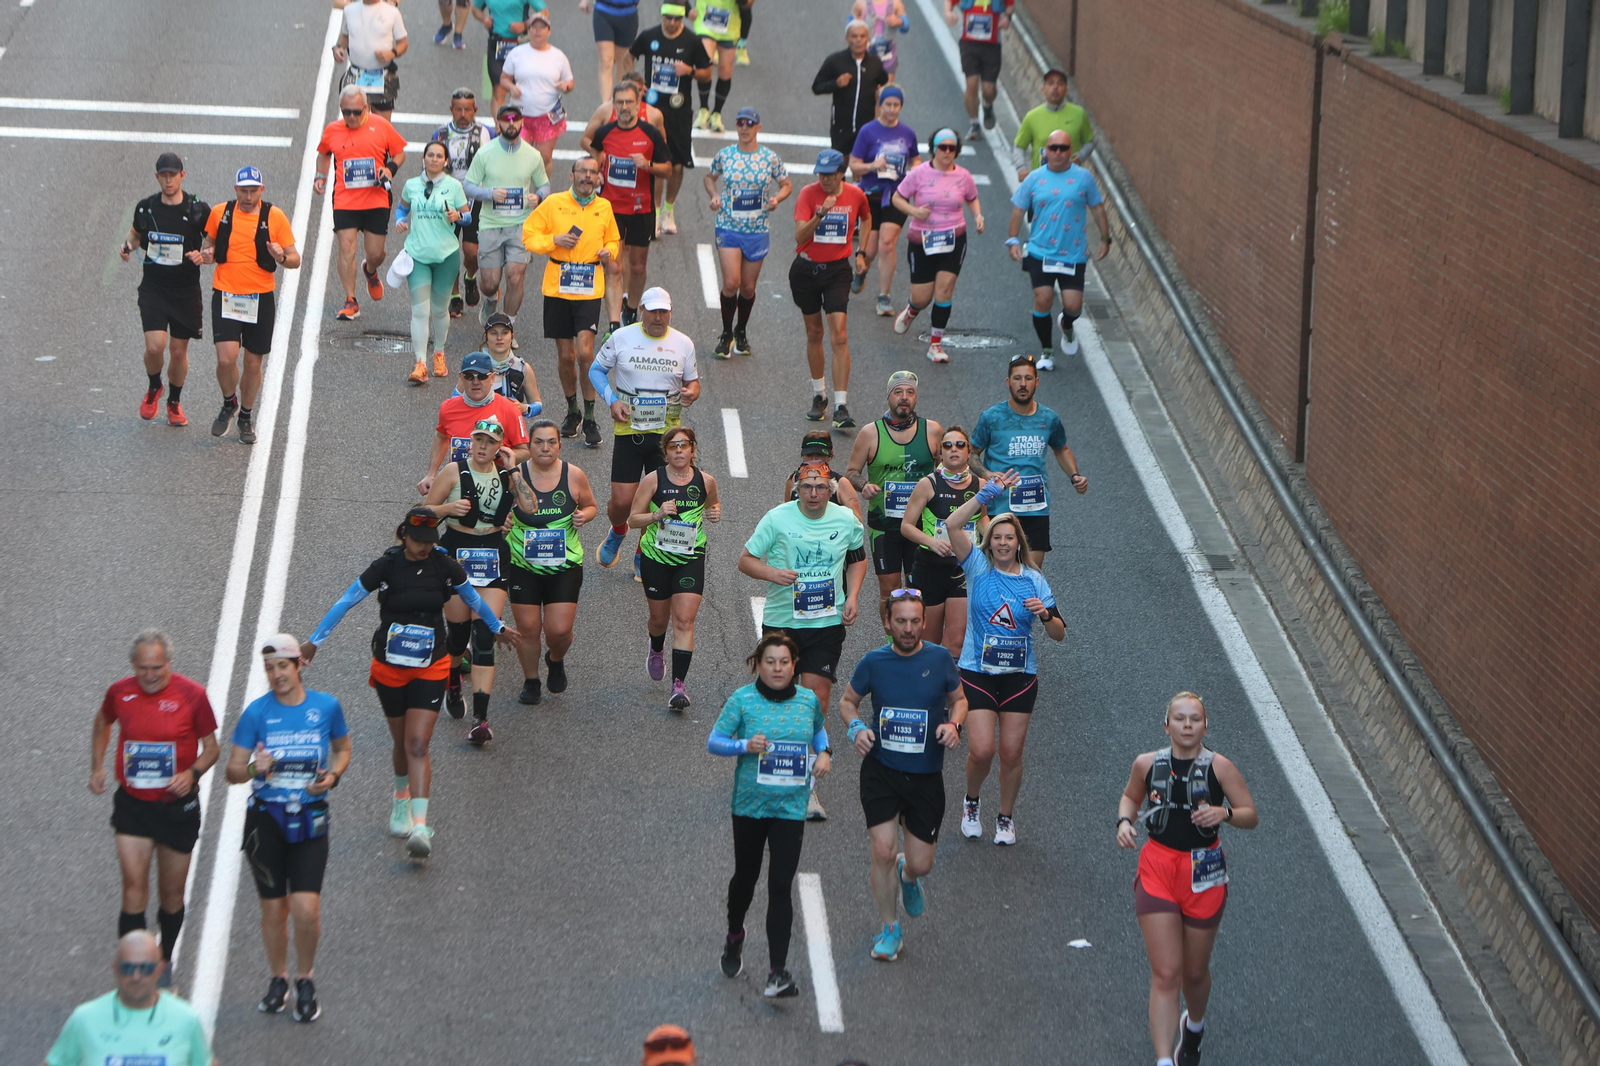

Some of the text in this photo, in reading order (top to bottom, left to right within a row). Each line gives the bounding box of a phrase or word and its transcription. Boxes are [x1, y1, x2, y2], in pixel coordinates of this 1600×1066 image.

[629, 356, 679, 367] ALMAGRO
[634, 364, 673, 373] MARATÓN
[483, 477, 500, 510] PRO
[796, 570, 831, 578] SEVILLA'24
[808, 582, 831, 590] ZURICH
[807, 595, 824, 603] 12004
[405, 627, 430, 637] ZURICH
[896, 711, 922, 720] ZURICH
[893, 725, 912, 734] 11333
[777, 744, 802, 752] ZURICH
